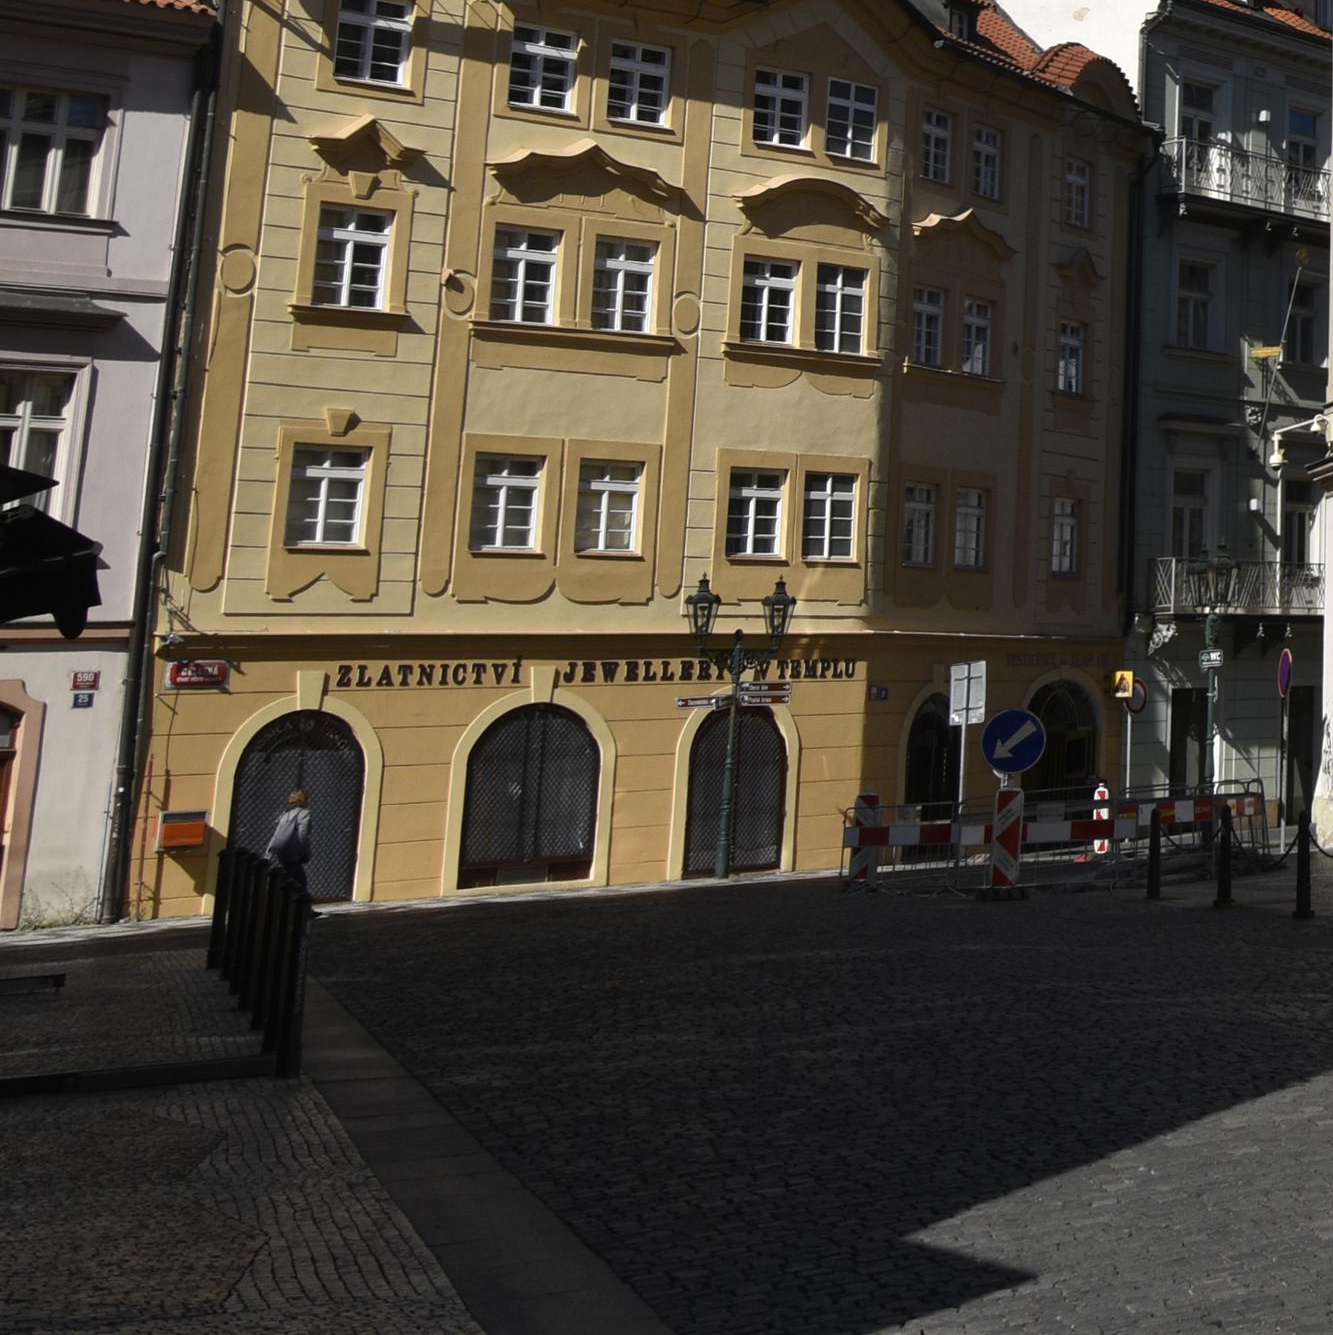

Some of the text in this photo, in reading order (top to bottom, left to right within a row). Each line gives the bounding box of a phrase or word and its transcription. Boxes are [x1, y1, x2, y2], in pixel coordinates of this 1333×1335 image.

[1209, 651, 1221, 661] WC
[336, 655, 522, 687] ZLATNICTVÍ
[563, 659, 728, 684] JEWELLERY
[777, 658, 857, 680] TEMPLU
